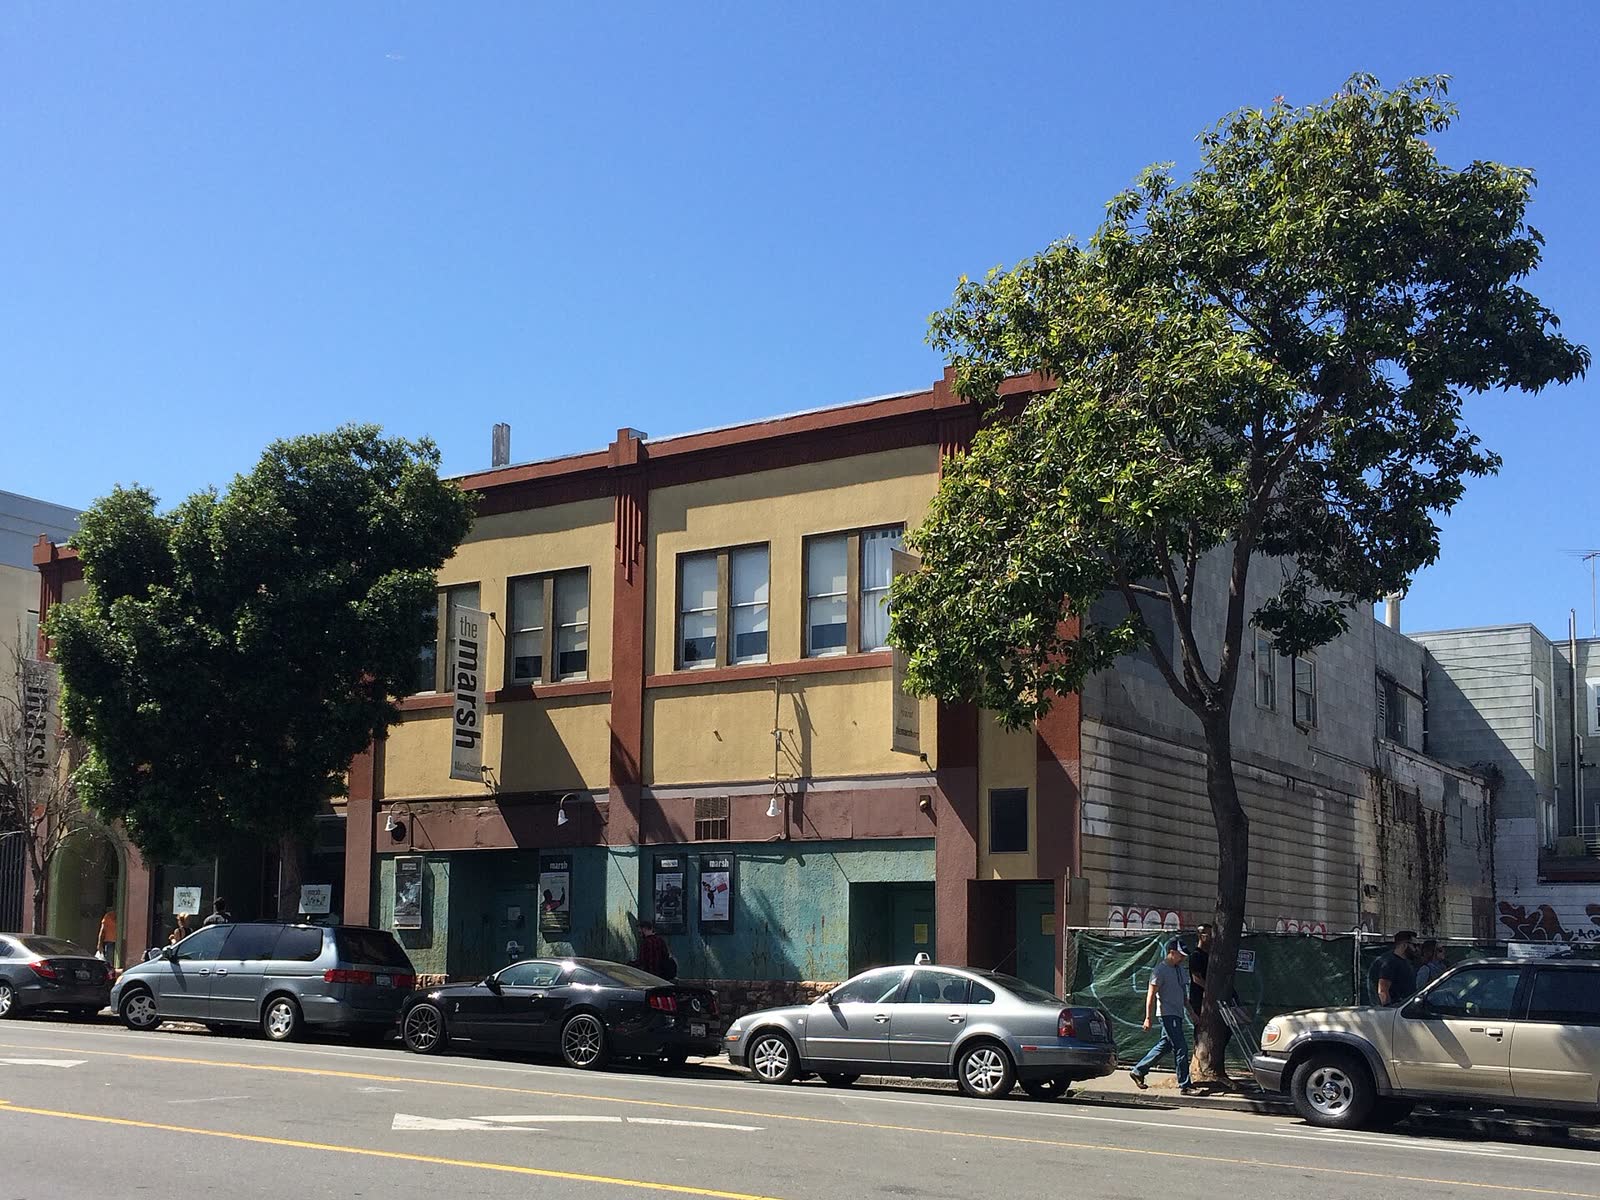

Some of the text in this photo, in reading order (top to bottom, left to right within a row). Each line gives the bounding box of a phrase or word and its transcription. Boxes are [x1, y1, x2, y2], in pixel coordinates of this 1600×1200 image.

[460, 616, 478, 639] the
[456, 639, 482, 749] marsh
[25, 687, 49, 778] marsh
[549, 861, 568, 870] marsh
[709, 858, 729, 868] marsh
